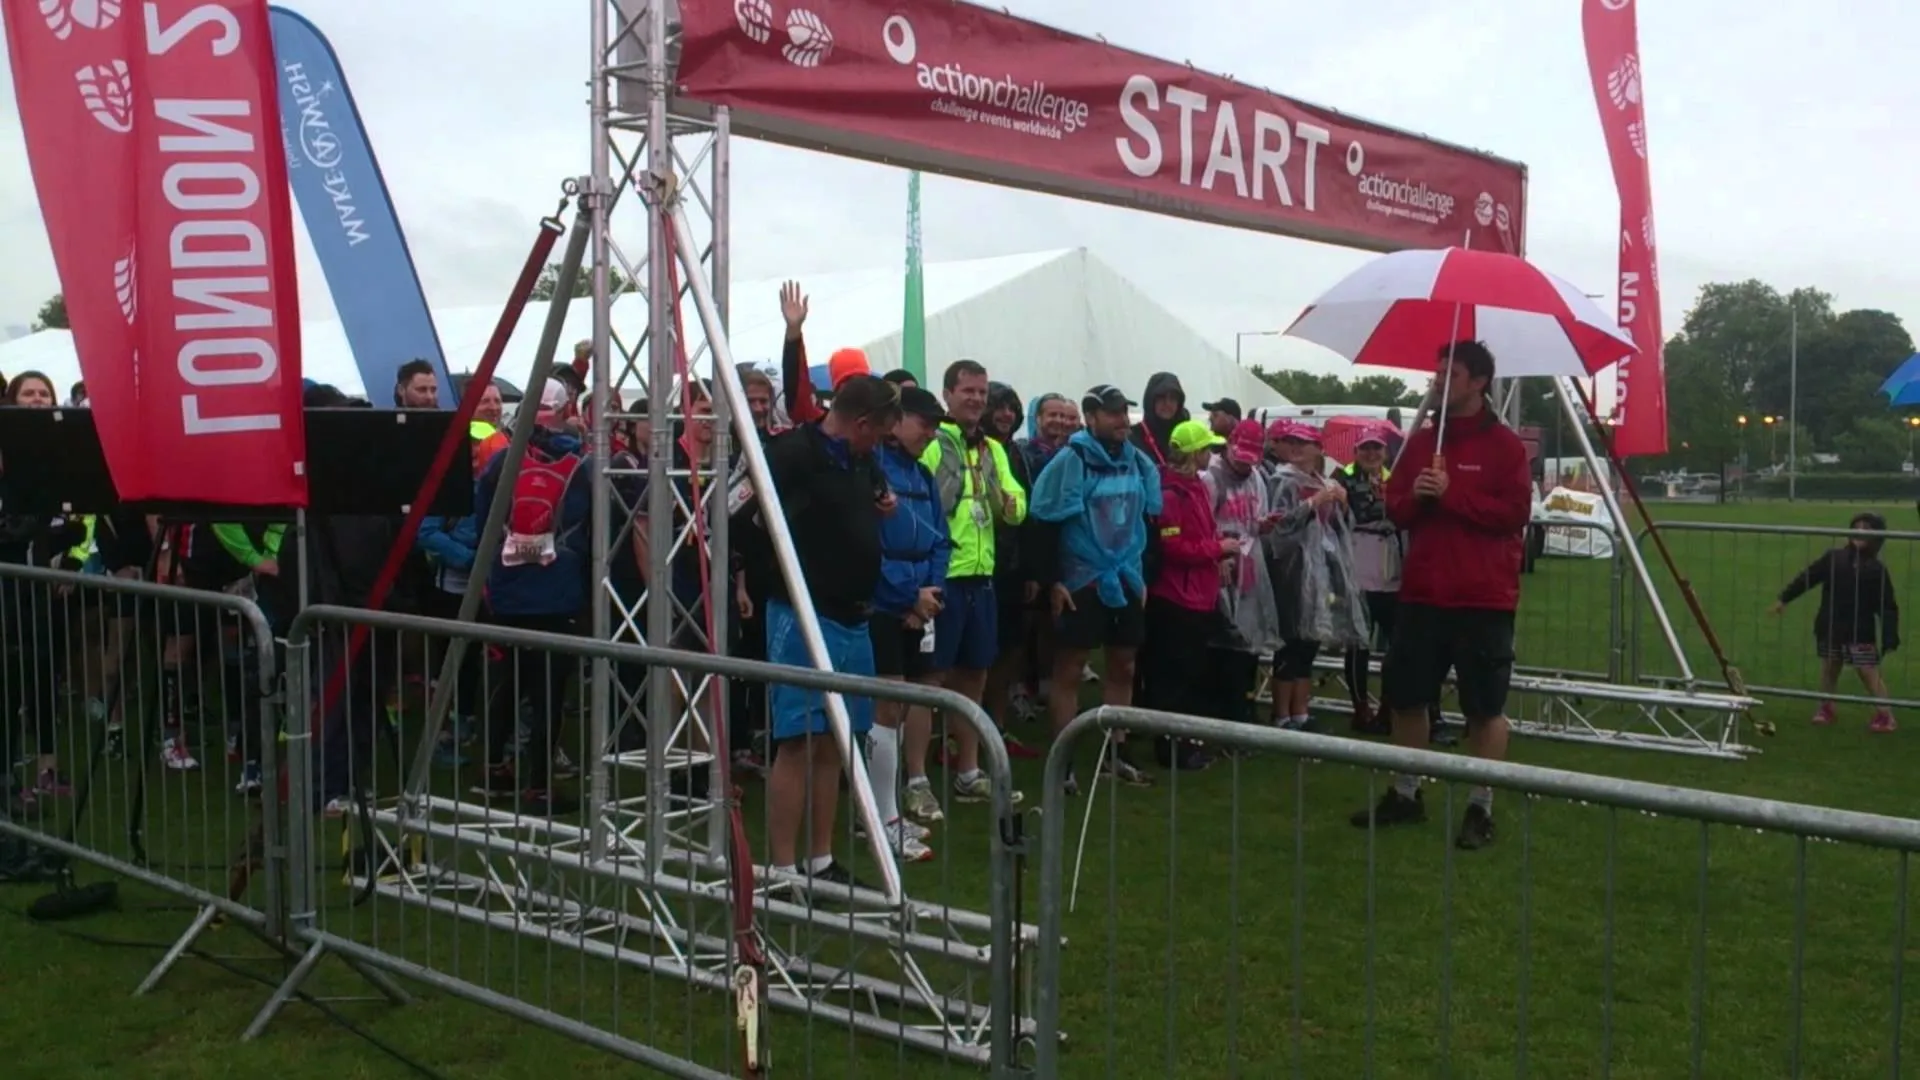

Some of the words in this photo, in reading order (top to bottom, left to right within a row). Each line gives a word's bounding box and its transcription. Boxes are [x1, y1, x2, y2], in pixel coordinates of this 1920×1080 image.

[917, 62, 1088, 132] actionchallenge
[930, 97, 979, 122] challenge
[979, 110, 1012, 129] events
[1012, 118, 1062, 139] worldwide
[1115, 74, 1330, 212] START
[1358, 172, 1455, 219] actionchallenge
